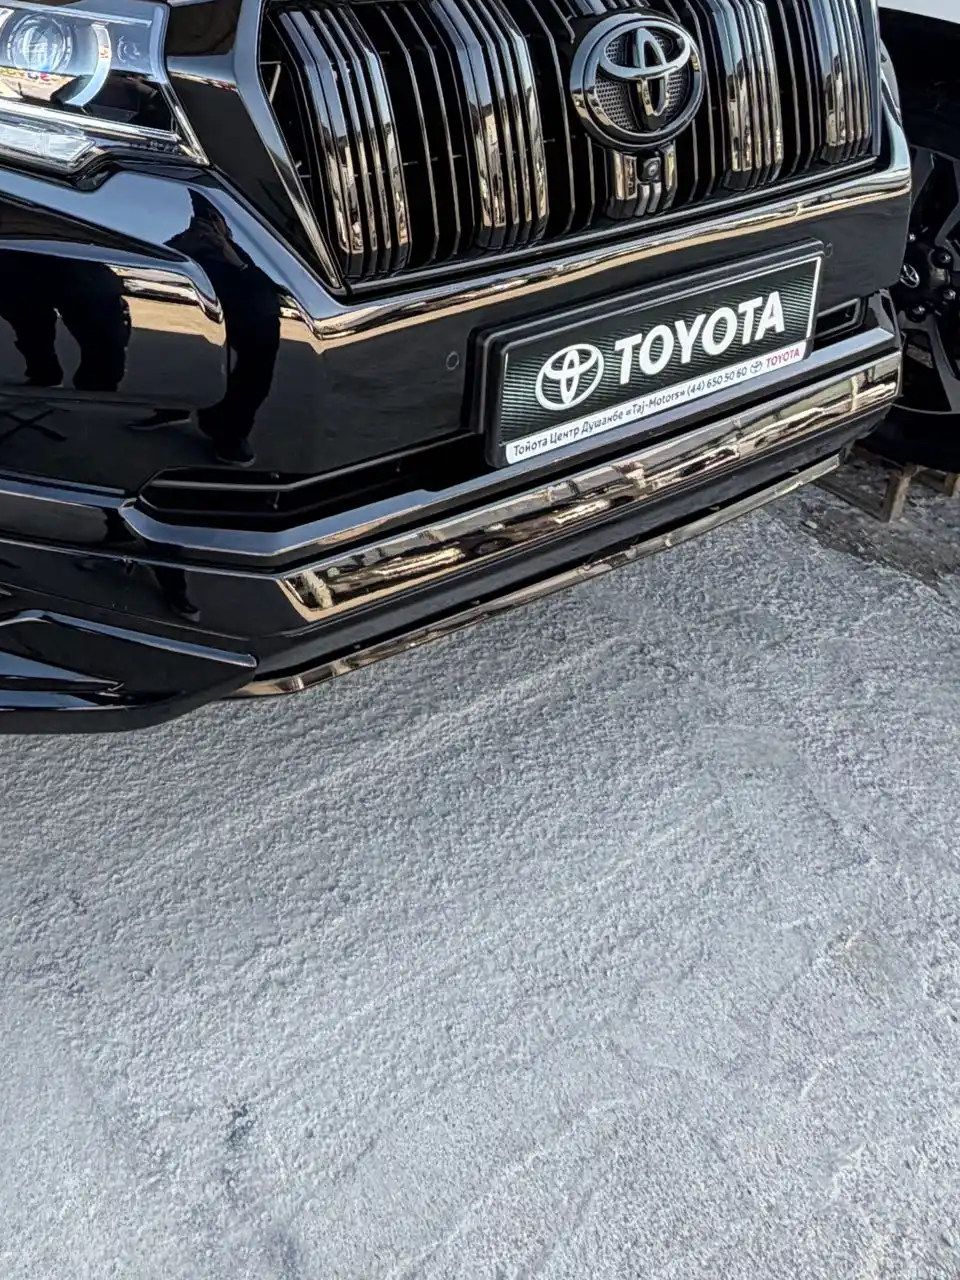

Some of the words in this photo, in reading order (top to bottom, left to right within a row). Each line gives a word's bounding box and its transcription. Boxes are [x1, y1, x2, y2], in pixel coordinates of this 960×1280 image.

[614, 291, 786, 385] TOYOTA
[765, 348, 800, 368] TOYOTA
[513, 439, 548, 457] Тойота
[550, 426, 580, 444] Центр
[580, 411, 624, 435] Душанбе
[626, 389, 685, 418] «Taj-Motors»
[686, 381, 706, 397] (44)
[706, 375, 723, 389] 650
[723, 371, 735, 383] 50
[736, 366, 748, 378] 60
